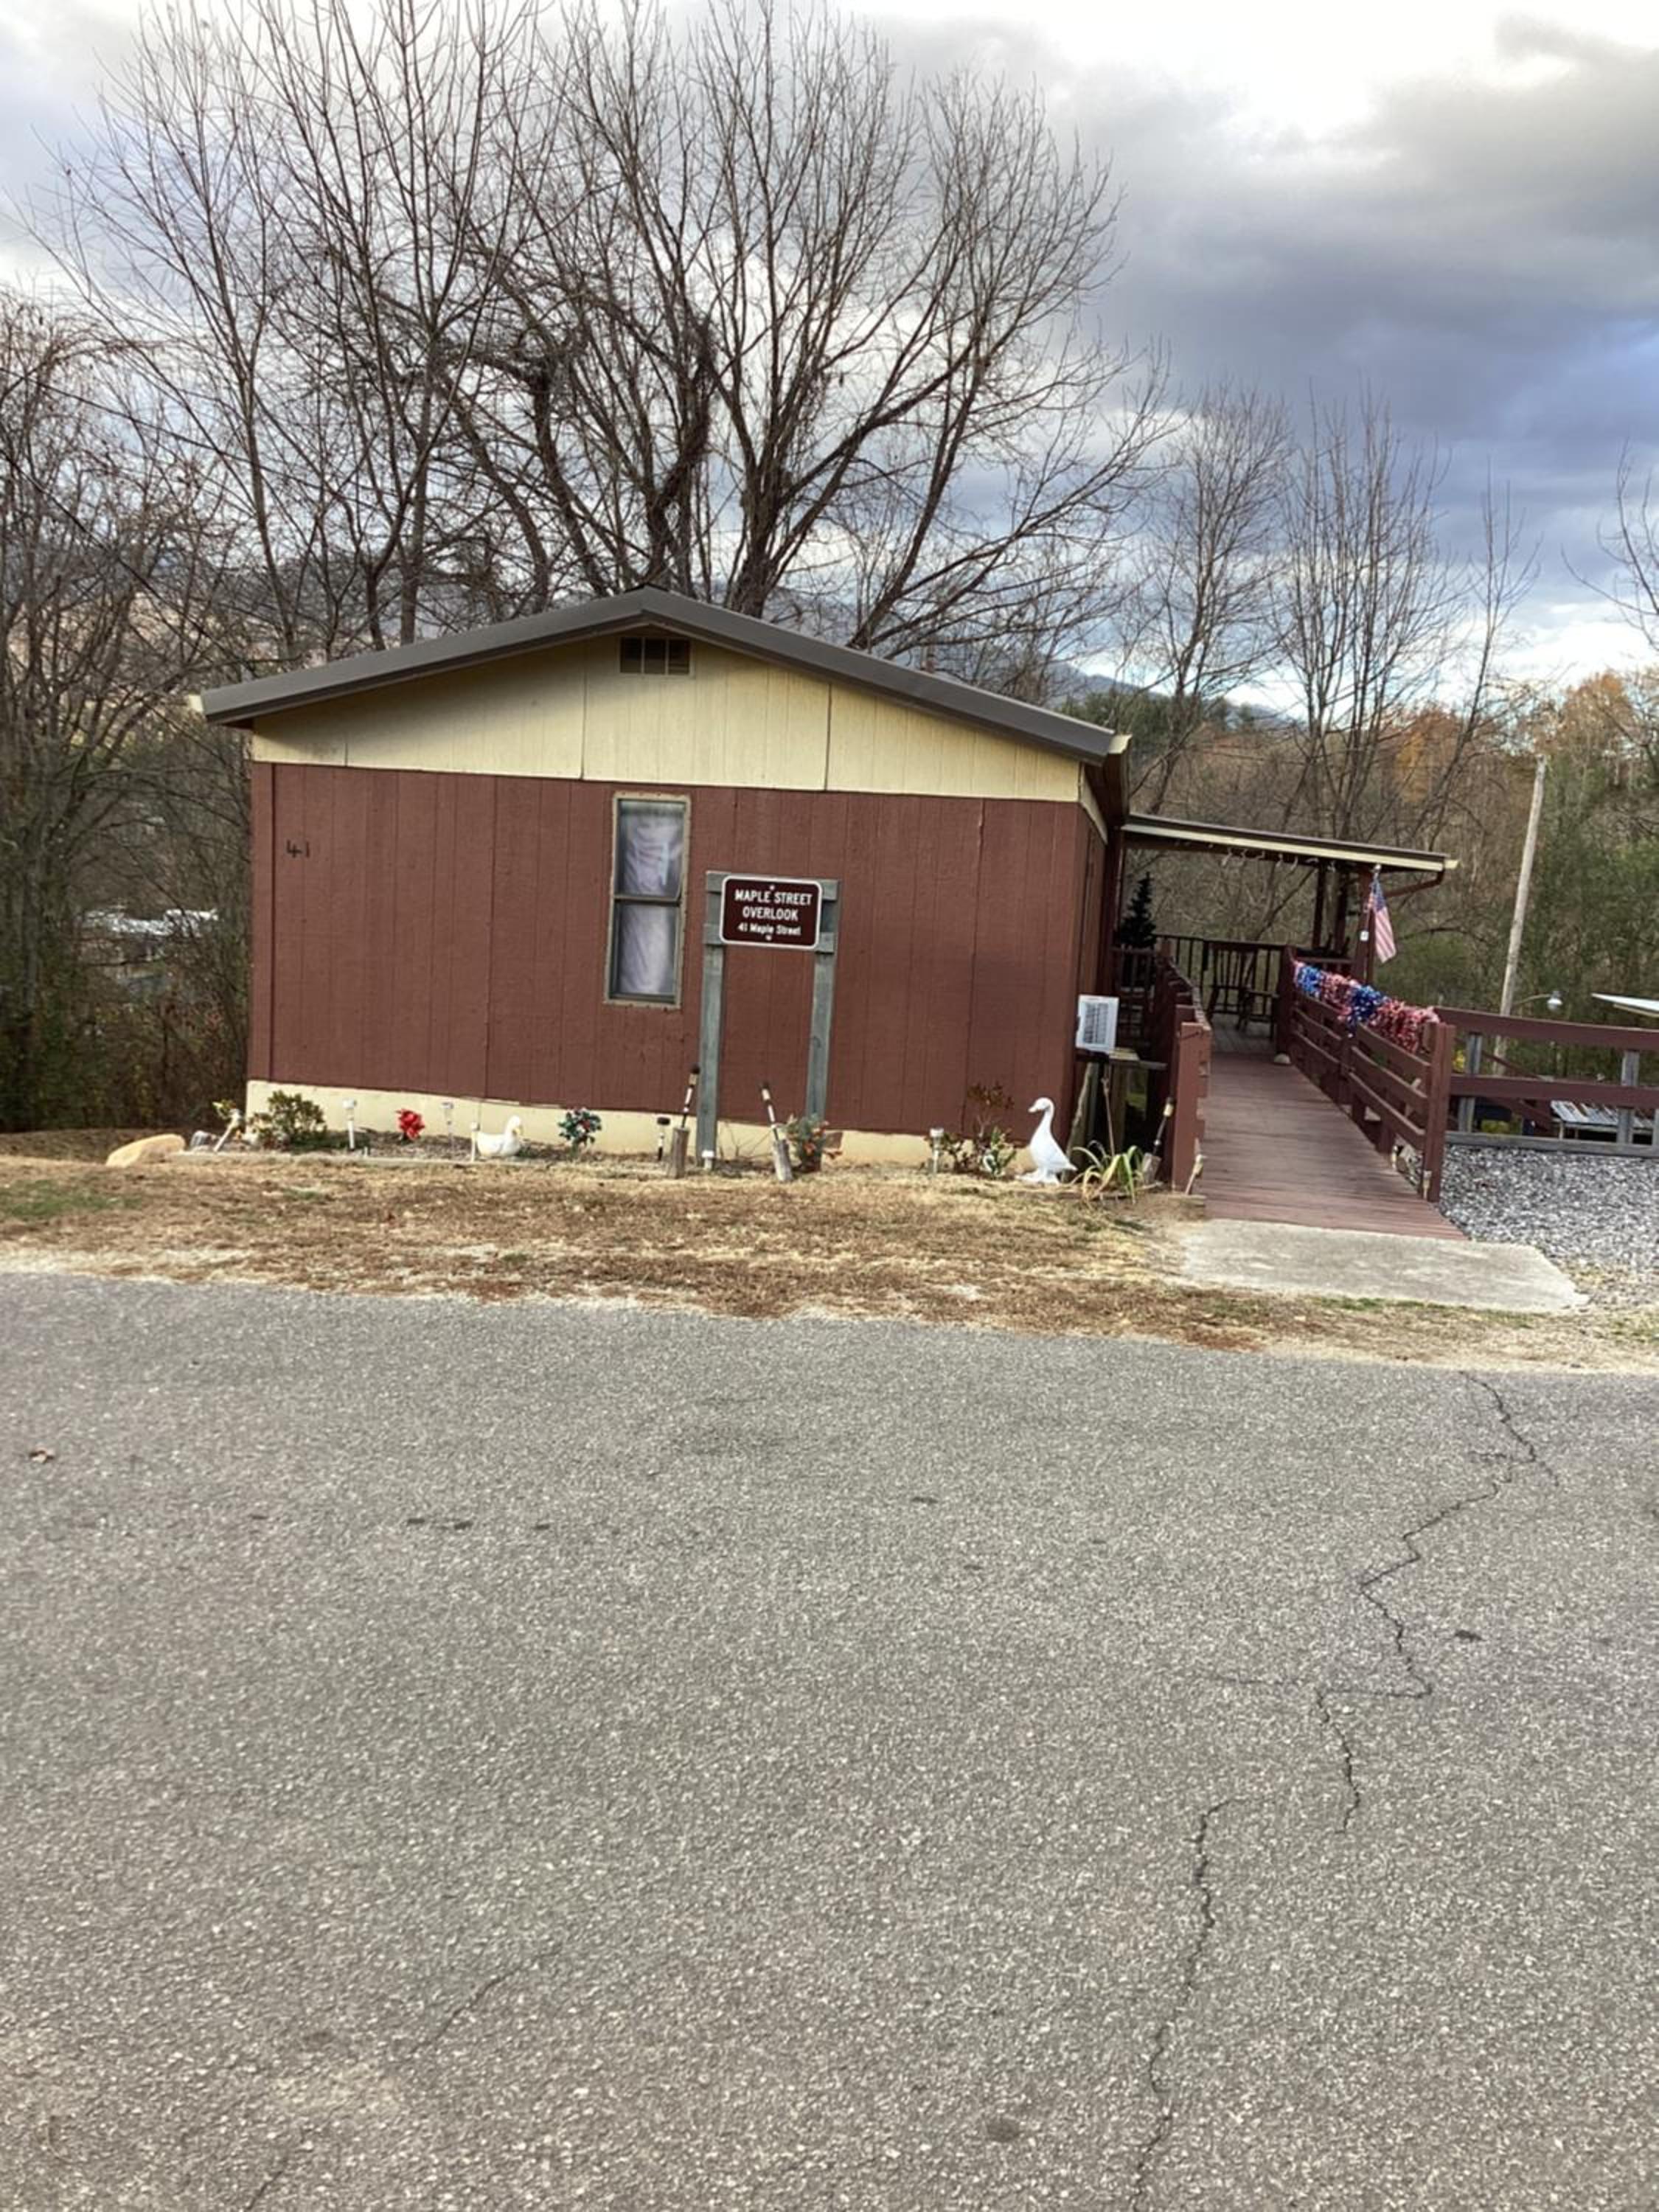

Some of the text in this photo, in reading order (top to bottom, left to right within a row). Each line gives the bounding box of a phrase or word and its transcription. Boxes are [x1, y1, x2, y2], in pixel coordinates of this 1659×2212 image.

[287, 839, 310, 858] 41
[734, 889, 813, 905] MAPLE STREET
[742, 906, 799, 921] OVERLOOK
[737, 922, 801, 936] 41 Maple Street
